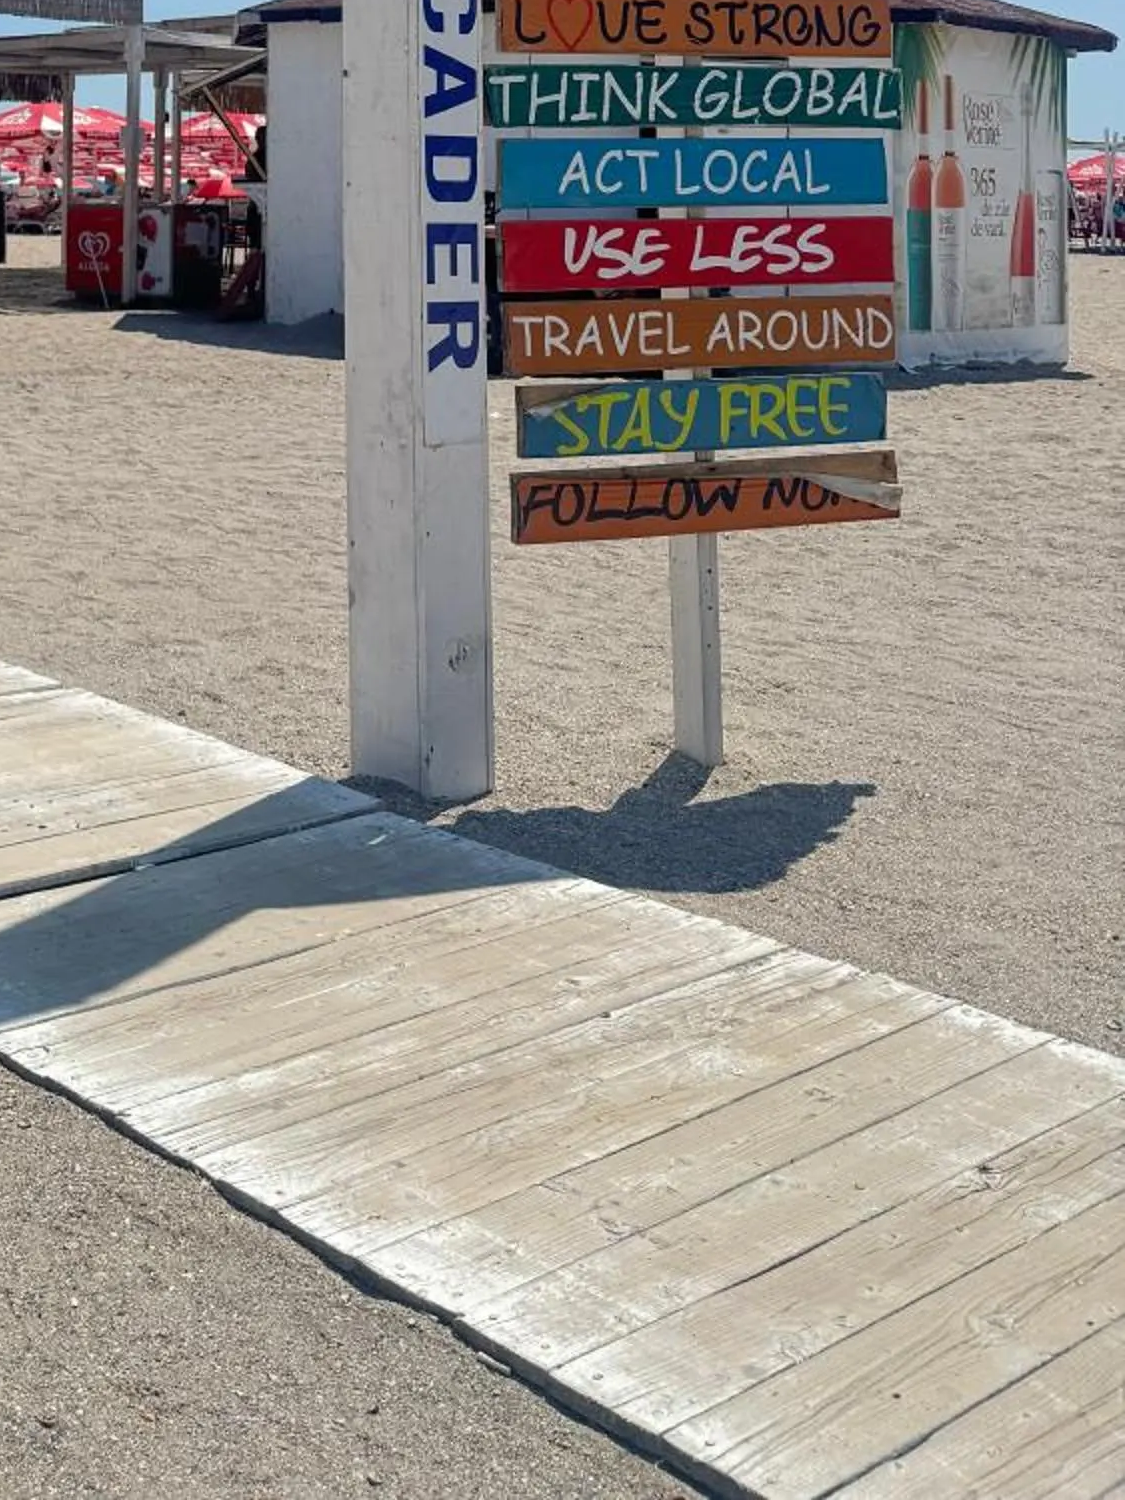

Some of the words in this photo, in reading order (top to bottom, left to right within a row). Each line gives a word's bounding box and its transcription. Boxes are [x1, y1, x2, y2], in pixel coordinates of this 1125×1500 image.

[684, 0, 881, 48] STRONG
[488, 70, 679, 124] THINK
[693, 68, 899, 120] GLOBAL
[558, 148, 660, 196] ACT
[674, 148, 831, 197] LOCAL
[563, 224, 671, 280] USE
[689, 222, 836, 274] LESS
[512, 310, 691, 358] TRAVEL
[706, 306, 894, 354] AROUND
[551, 386, 701, 457] STAY
[716, 375, 852, 445] FREE
[520, 476, 742, 529] FOLLOW
